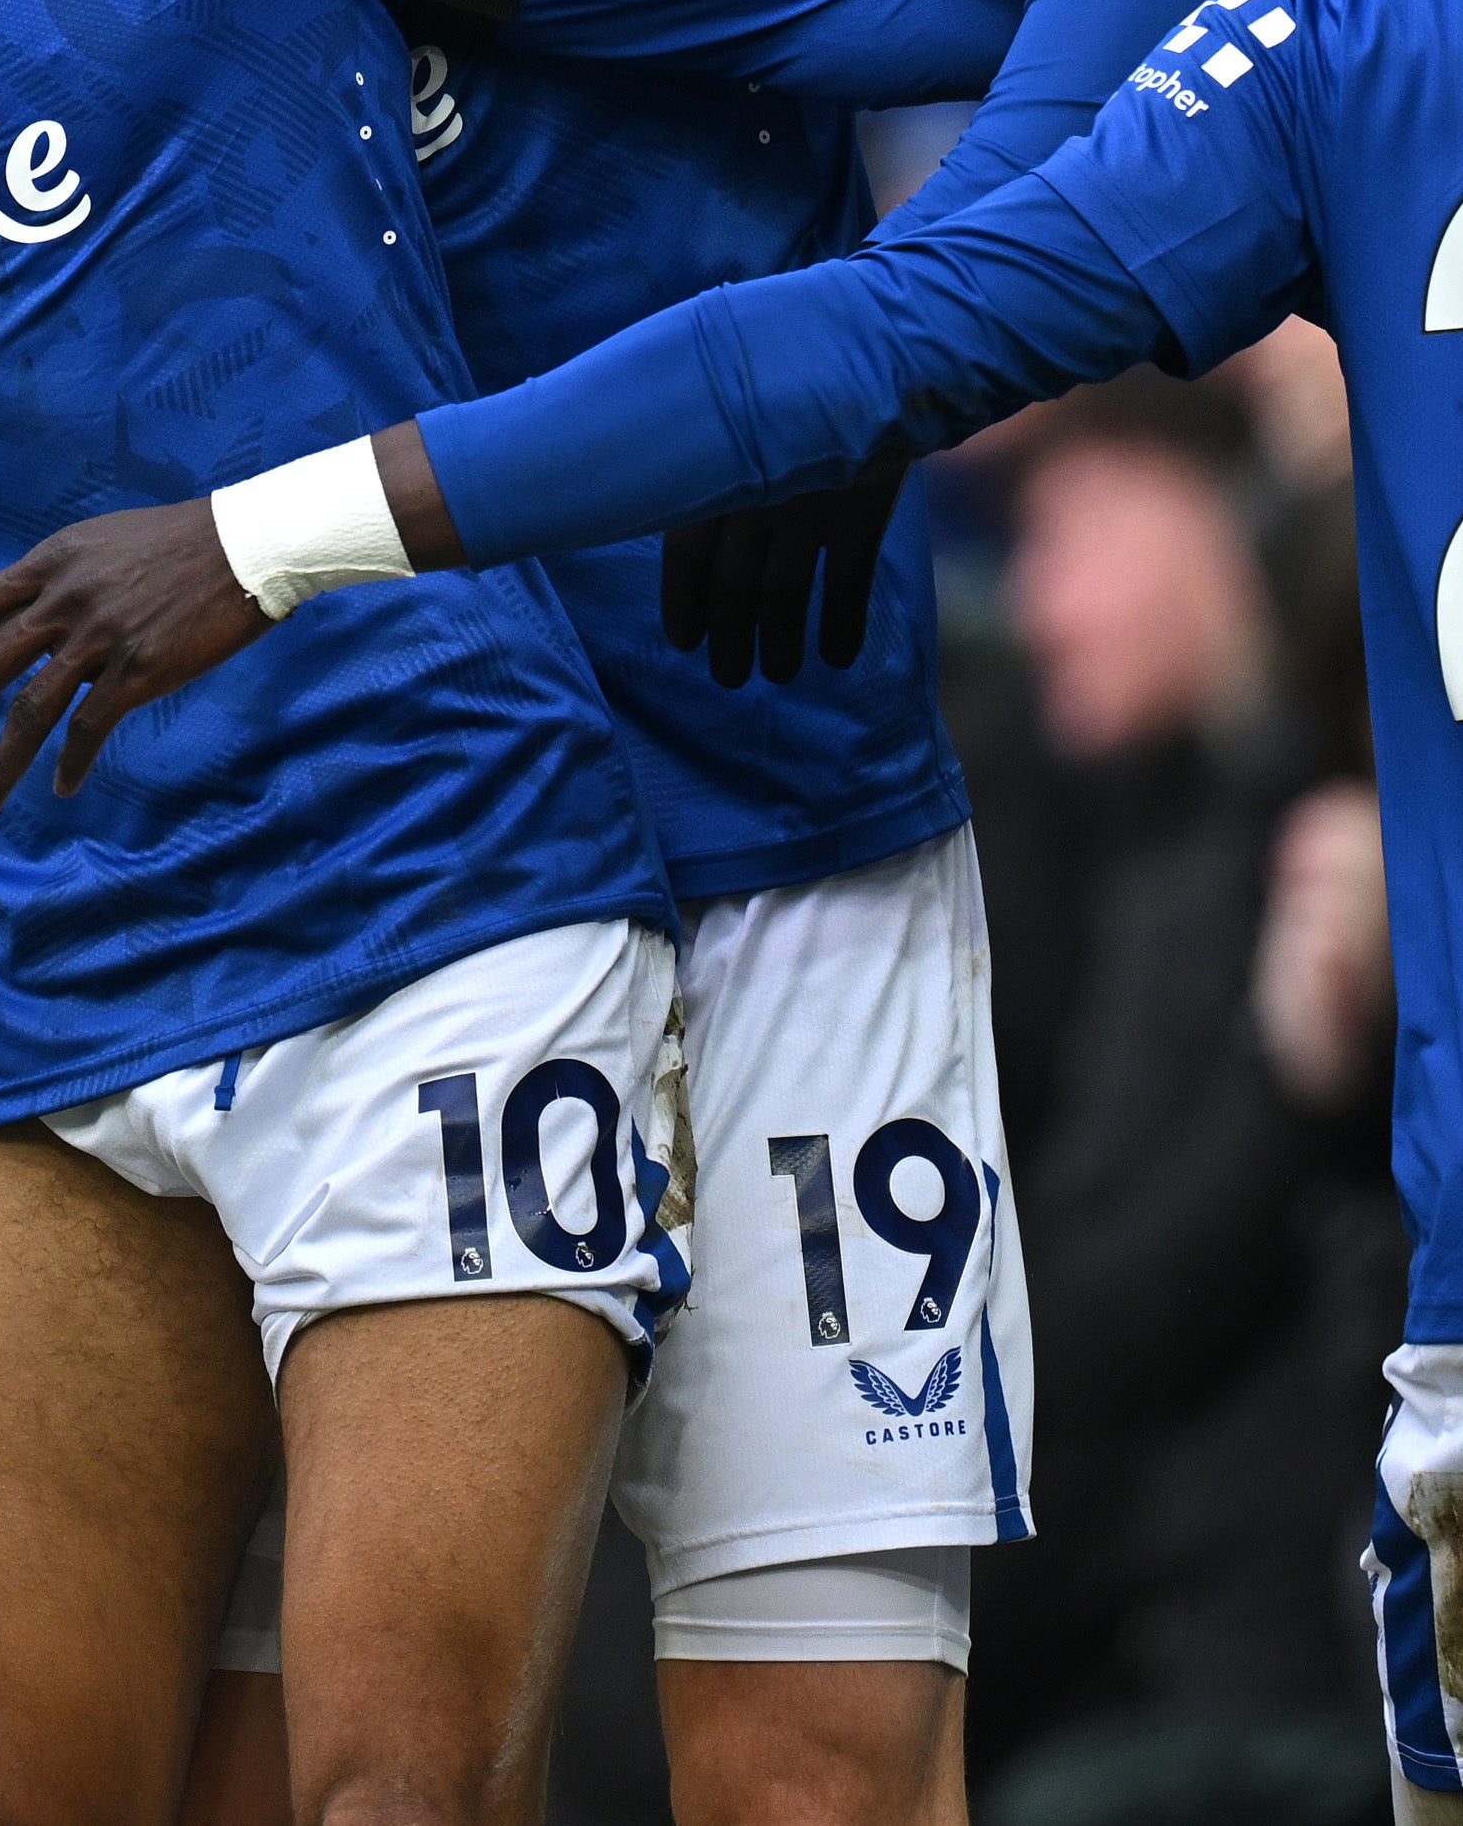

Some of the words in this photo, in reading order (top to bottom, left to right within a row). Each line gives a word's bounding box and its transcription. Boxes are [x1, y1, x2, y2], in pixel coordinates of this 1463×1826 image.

[418, 1058, 627, 1282] 10
[767, 1118, 981, 1349] 19
[865, 1419, 967, 1445] CASTORE
